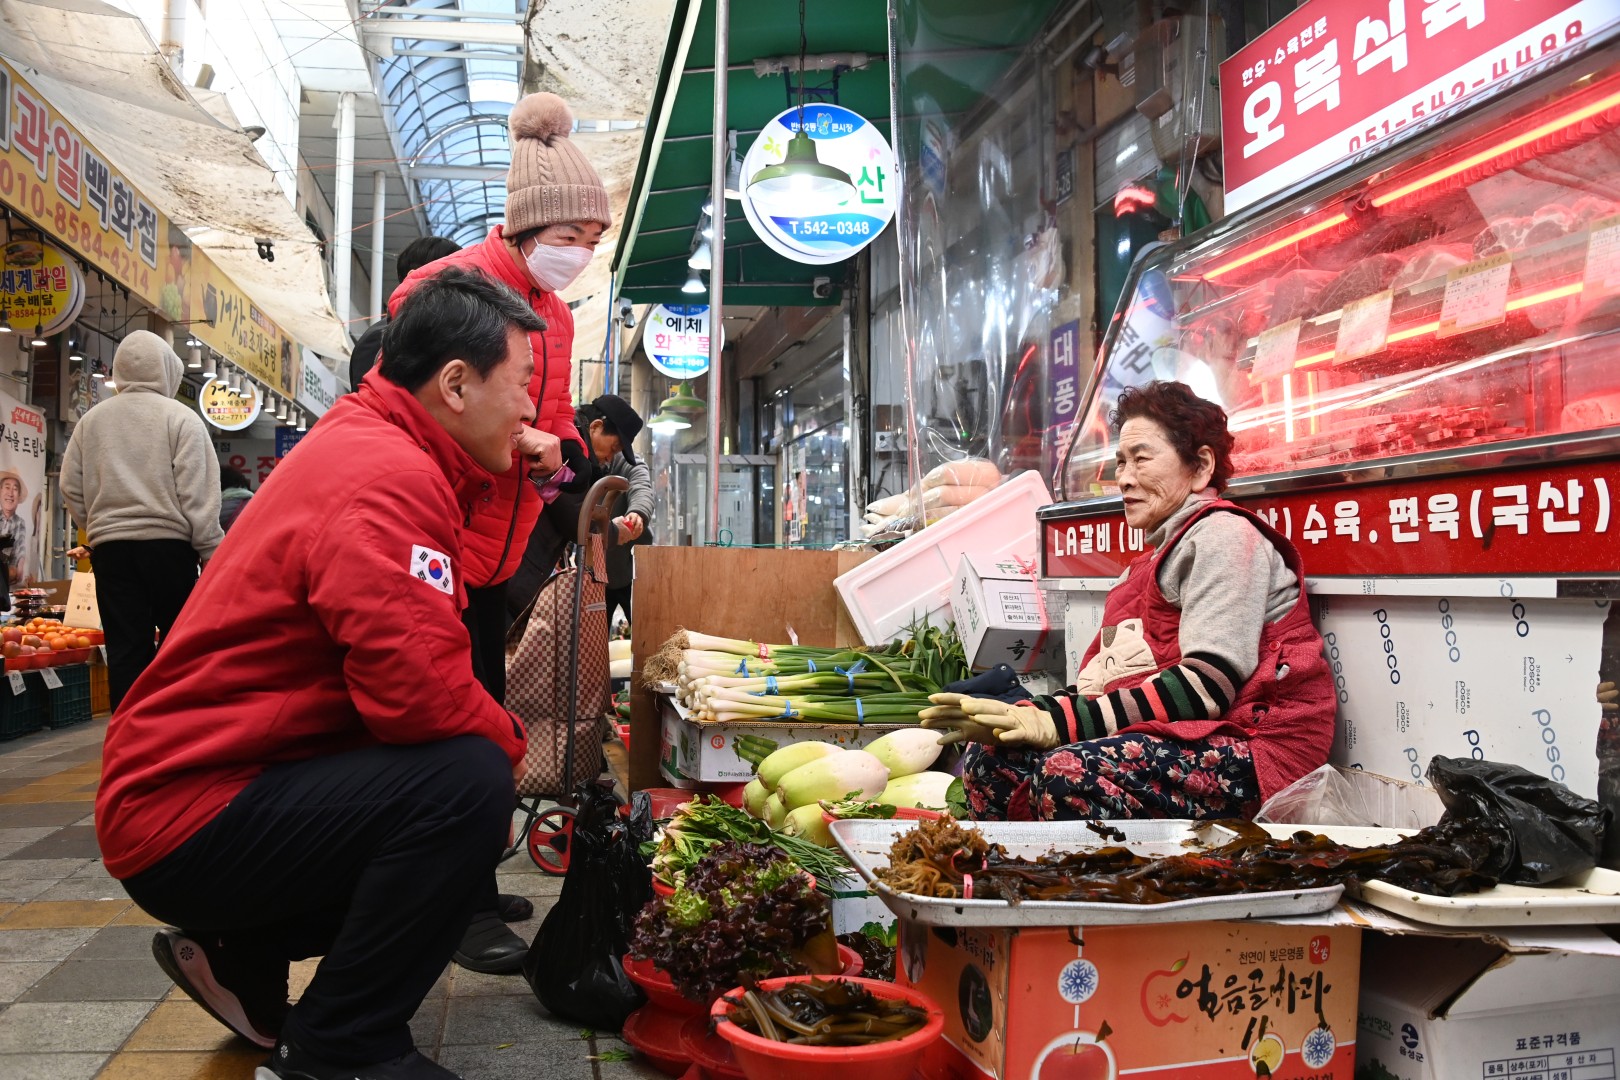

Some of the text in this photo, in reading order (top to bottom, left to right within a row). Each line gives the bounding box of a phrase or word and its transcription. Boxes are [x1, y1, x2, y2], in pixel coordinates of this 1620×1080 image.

[832, 123, 854, 134] 큰시장
[0, 158, 150, 294] 010-8584-4214
[789, 221, 870, 235] T.542-0348
[0, 265, 68, 294] 세계과일
[7, 307, 57, 319] 0-8584-4214
[1054, 522, 1111, 557] LA갈비
[1438, 598, 1461, 663] osco
[1372, 608, 1401, 685] posco
[1323, 631, 1349, 704] posco
[1527, 656, 1535, 693] posco
[1531, 708, 1568, 791] posc
[1238, 950, 1267, 966] 천연이
[1400, 1045, 1424, 1063] 음성군
[1515, 1032, 1581, 1051] 표준규격품
[1488, 1063, 1504, 1074] 품목
[1510, 1059, 1547, 1072] 상추(포기)
